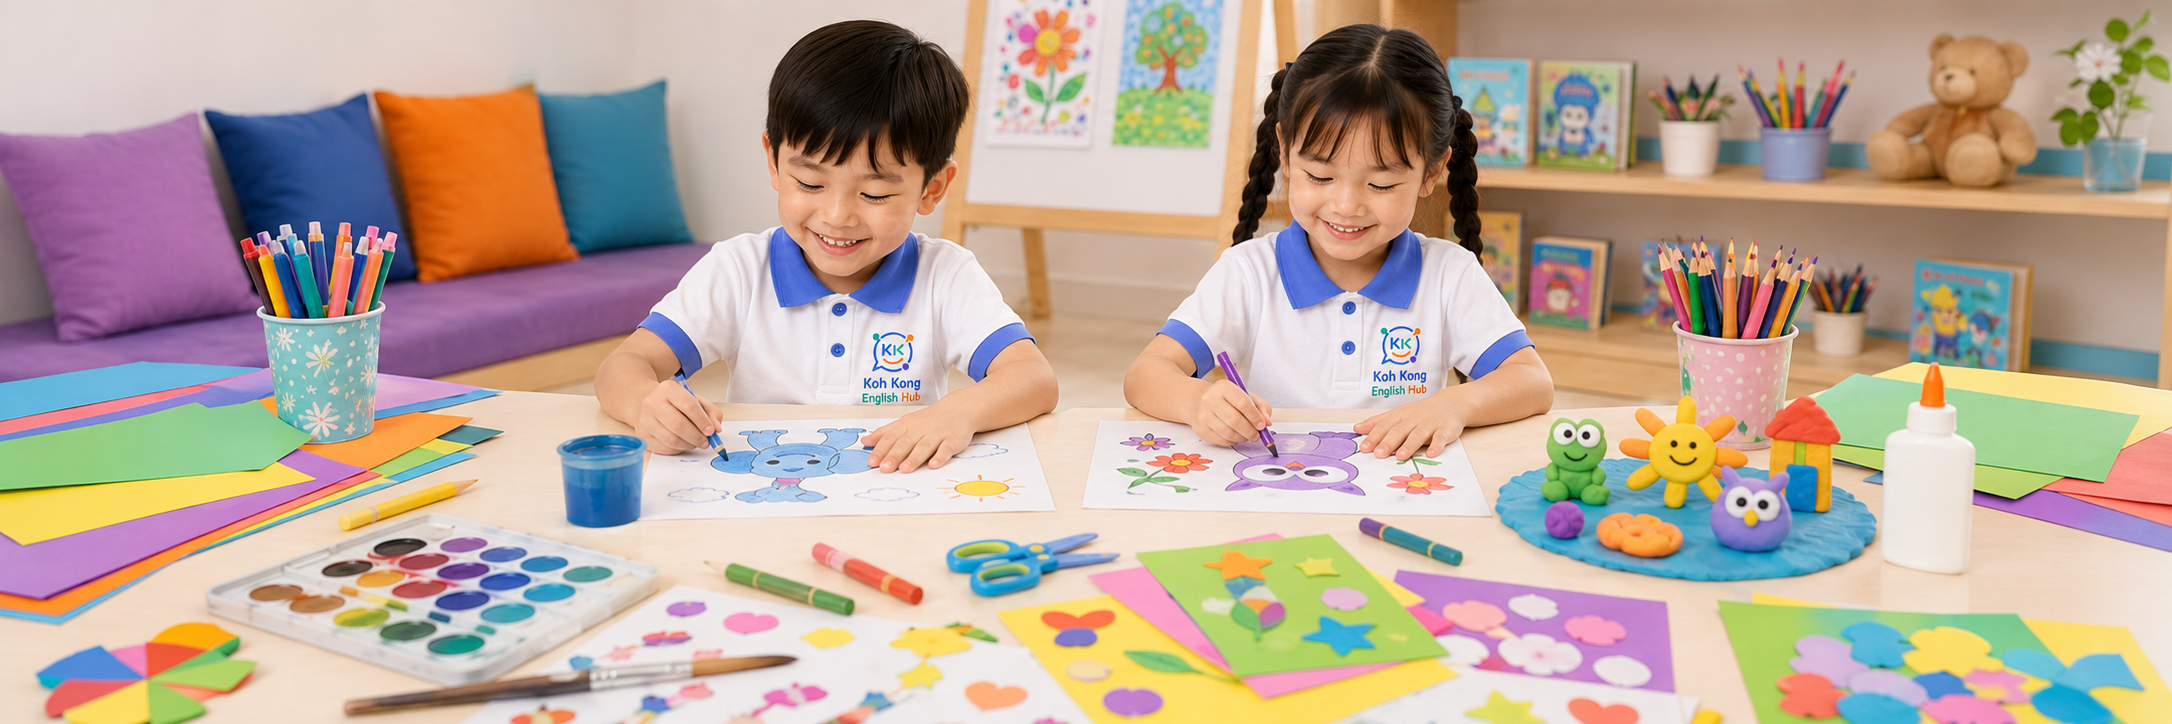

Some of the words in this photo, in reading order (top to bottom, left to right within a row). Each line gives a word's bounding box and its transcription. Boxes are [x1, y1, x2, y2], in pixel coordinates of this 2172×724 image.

[881, 343, 904, 356] KK
[1390, 337, 1411, 350] KK
[1373, 370, 1396, 382] Koh
[1400, 370, 1427, 383] Kong
[863, 377, 887, 389] Koh
[891, 377, 921, 391] Kong
[1372, 385, 1405, 398] English
[1408, 384, 1427, 394] Hub
[862, 392, 898, 405] English
[901, 392, 920, 402] Hub
